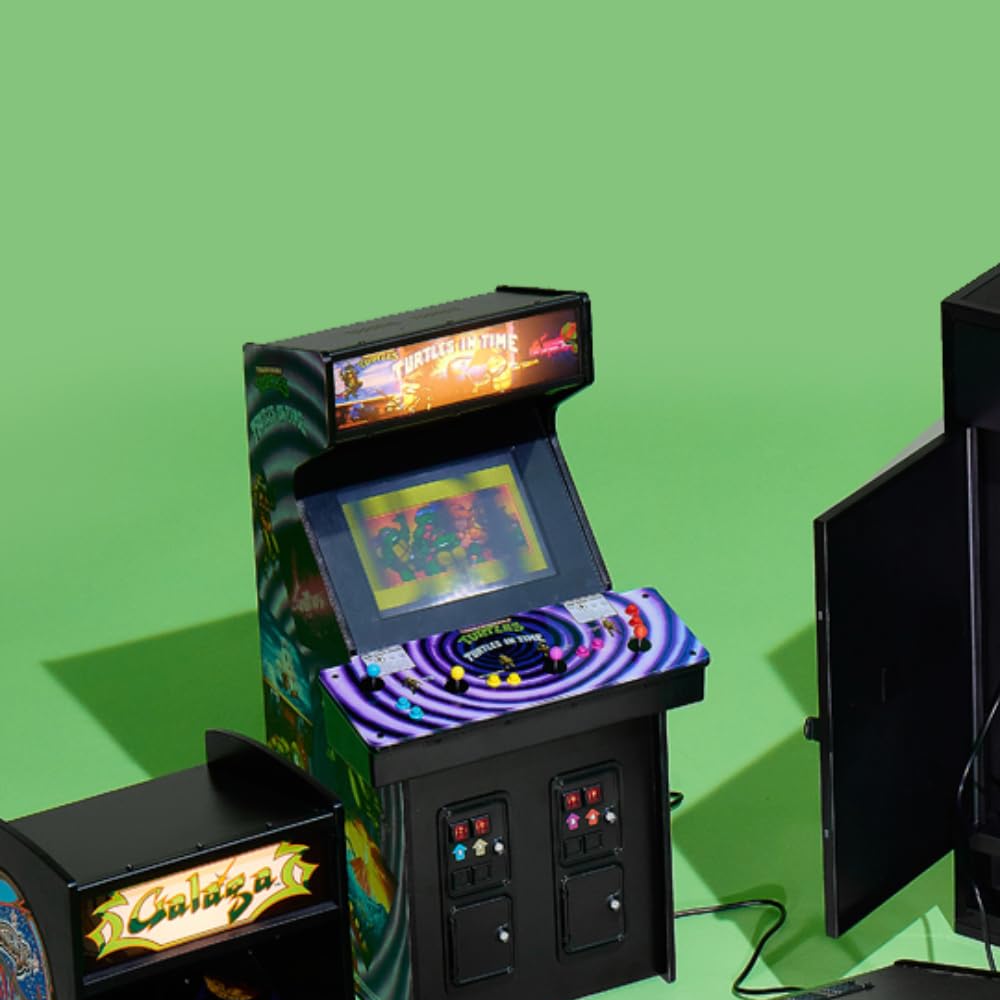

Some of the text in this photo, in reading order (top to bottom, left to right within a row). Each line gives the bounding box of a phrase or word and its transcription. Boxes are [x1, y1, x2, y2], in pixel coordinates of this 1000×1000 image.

[391, 333, 518, 377] TURTLES IN TIME
